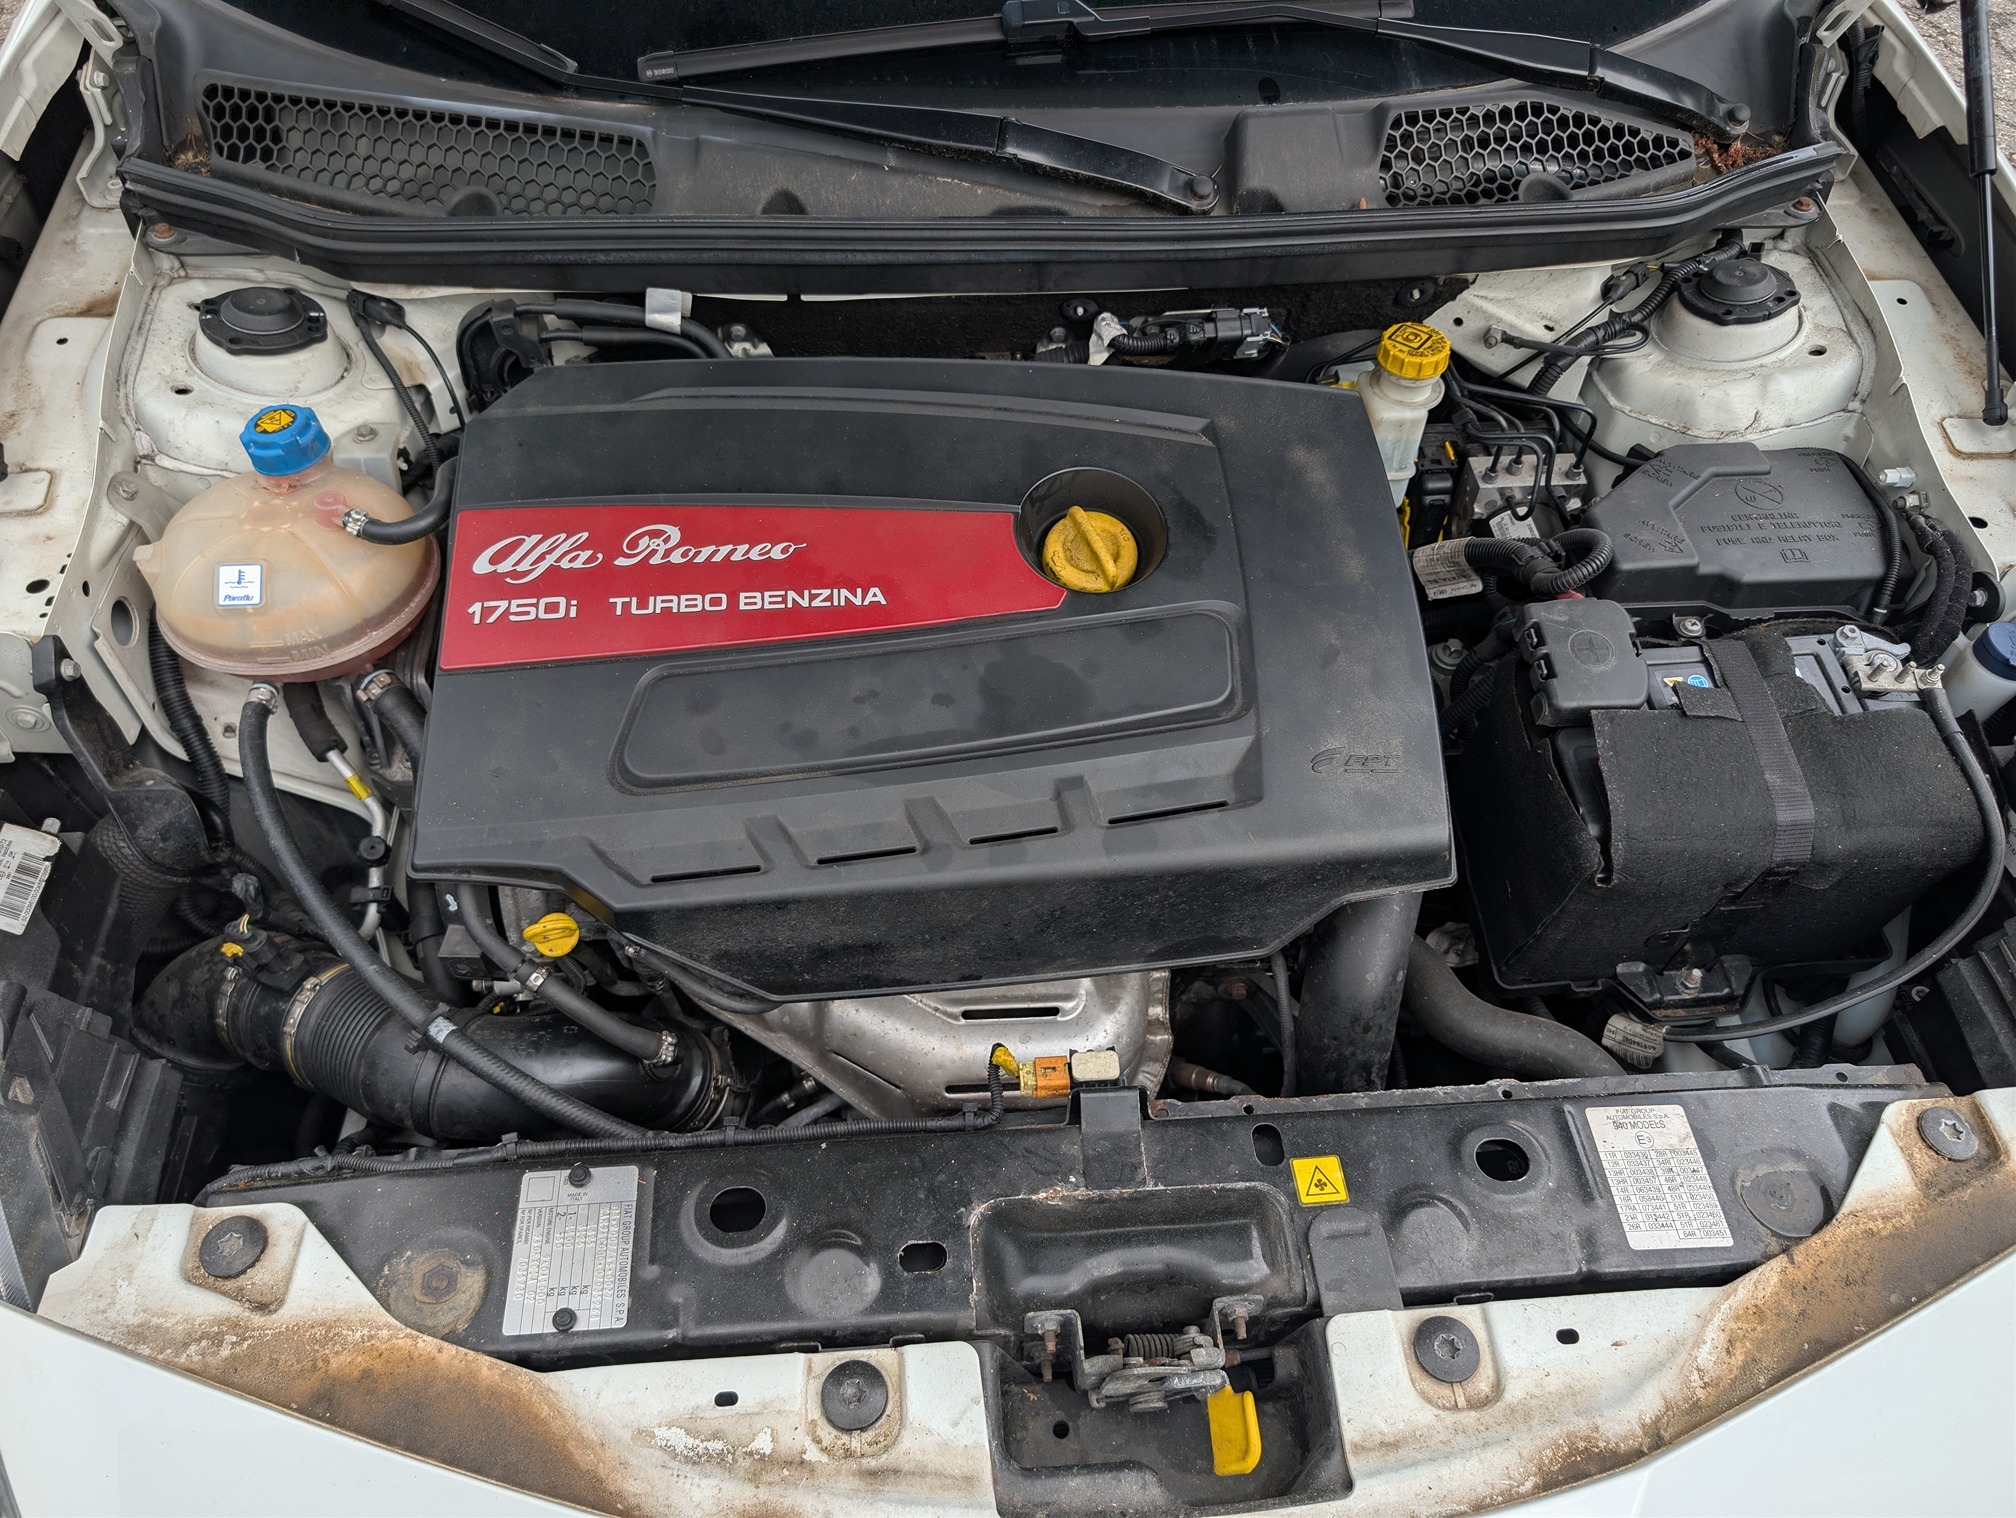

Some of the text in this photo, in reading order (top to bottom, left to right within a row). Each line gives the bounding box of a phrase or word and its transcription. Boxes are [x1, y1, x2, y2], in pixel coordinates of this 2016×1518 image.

[1715, 537, 1747, 546] FUSE
[1777, 534, 1813, 543] RELAY
[1816, 534, 1840, 542] BOX
[471, 523, 809, 585] Alfa Romeo
[466, 587, 888, 625] 1750i TURBO BENZINA
[285, 627, 323, 646] MAX
[291, 643, 331, 662] MIN
[1613, 1120, 1666, 1130] 940 MODELS
[623, 1203, 633, 1219] FIAT
[621, 1221, 631, 1247] GROUP
[616, 1248, 630, 1299] AUTOMOBILES
[547, 1287, 557, 1297] kg
[558, 1286, 569, 1296] kg
[569, 1285, 579, 1296] kg
[580, 1284, 591, 1295] kg
